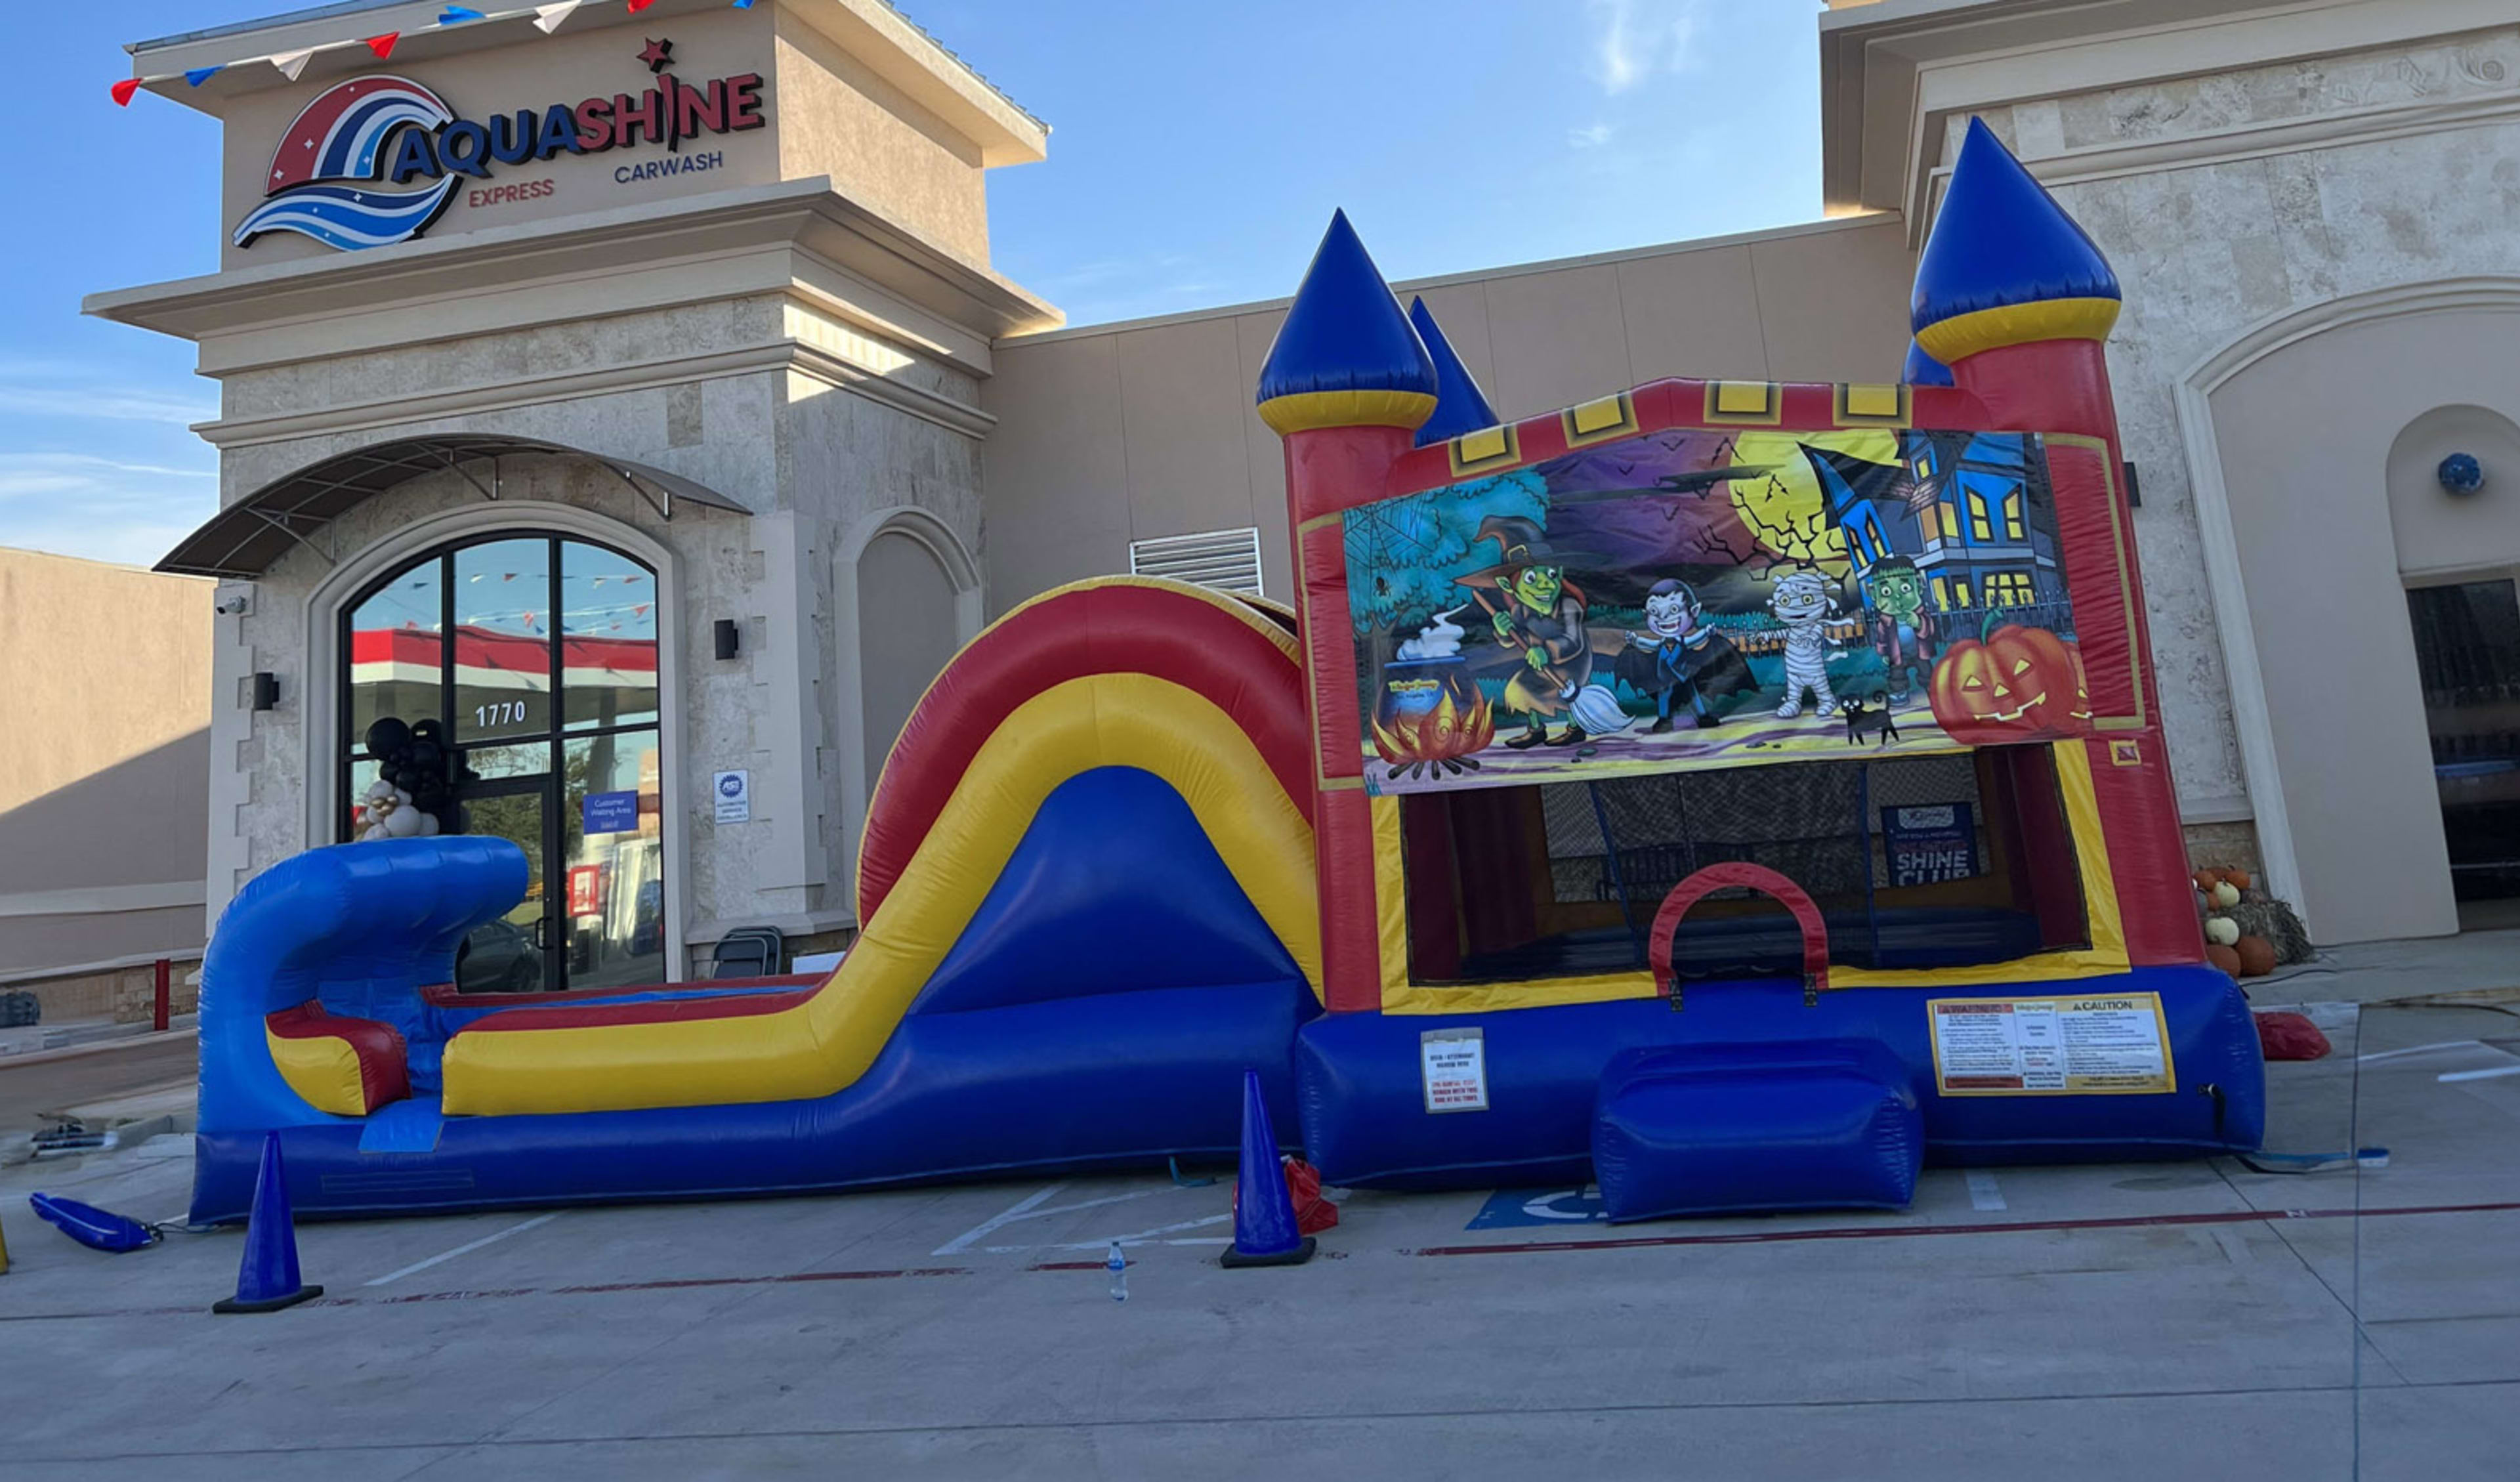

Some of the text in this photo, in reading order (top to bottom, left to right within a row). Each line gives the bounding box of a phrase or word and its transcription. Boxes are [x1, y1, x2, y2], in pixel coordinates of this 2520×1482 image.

[390, 74, 765, 184] AQUASHINE
[614, 151, 723, 184] CARWASH
[469, 179, 555, 208] EXPRESS
[474, 700, 526, 727] 1770
[1896, 850, 1969, 870] SHINE
[2082, 1000, 2133, 1011] CAUTION
